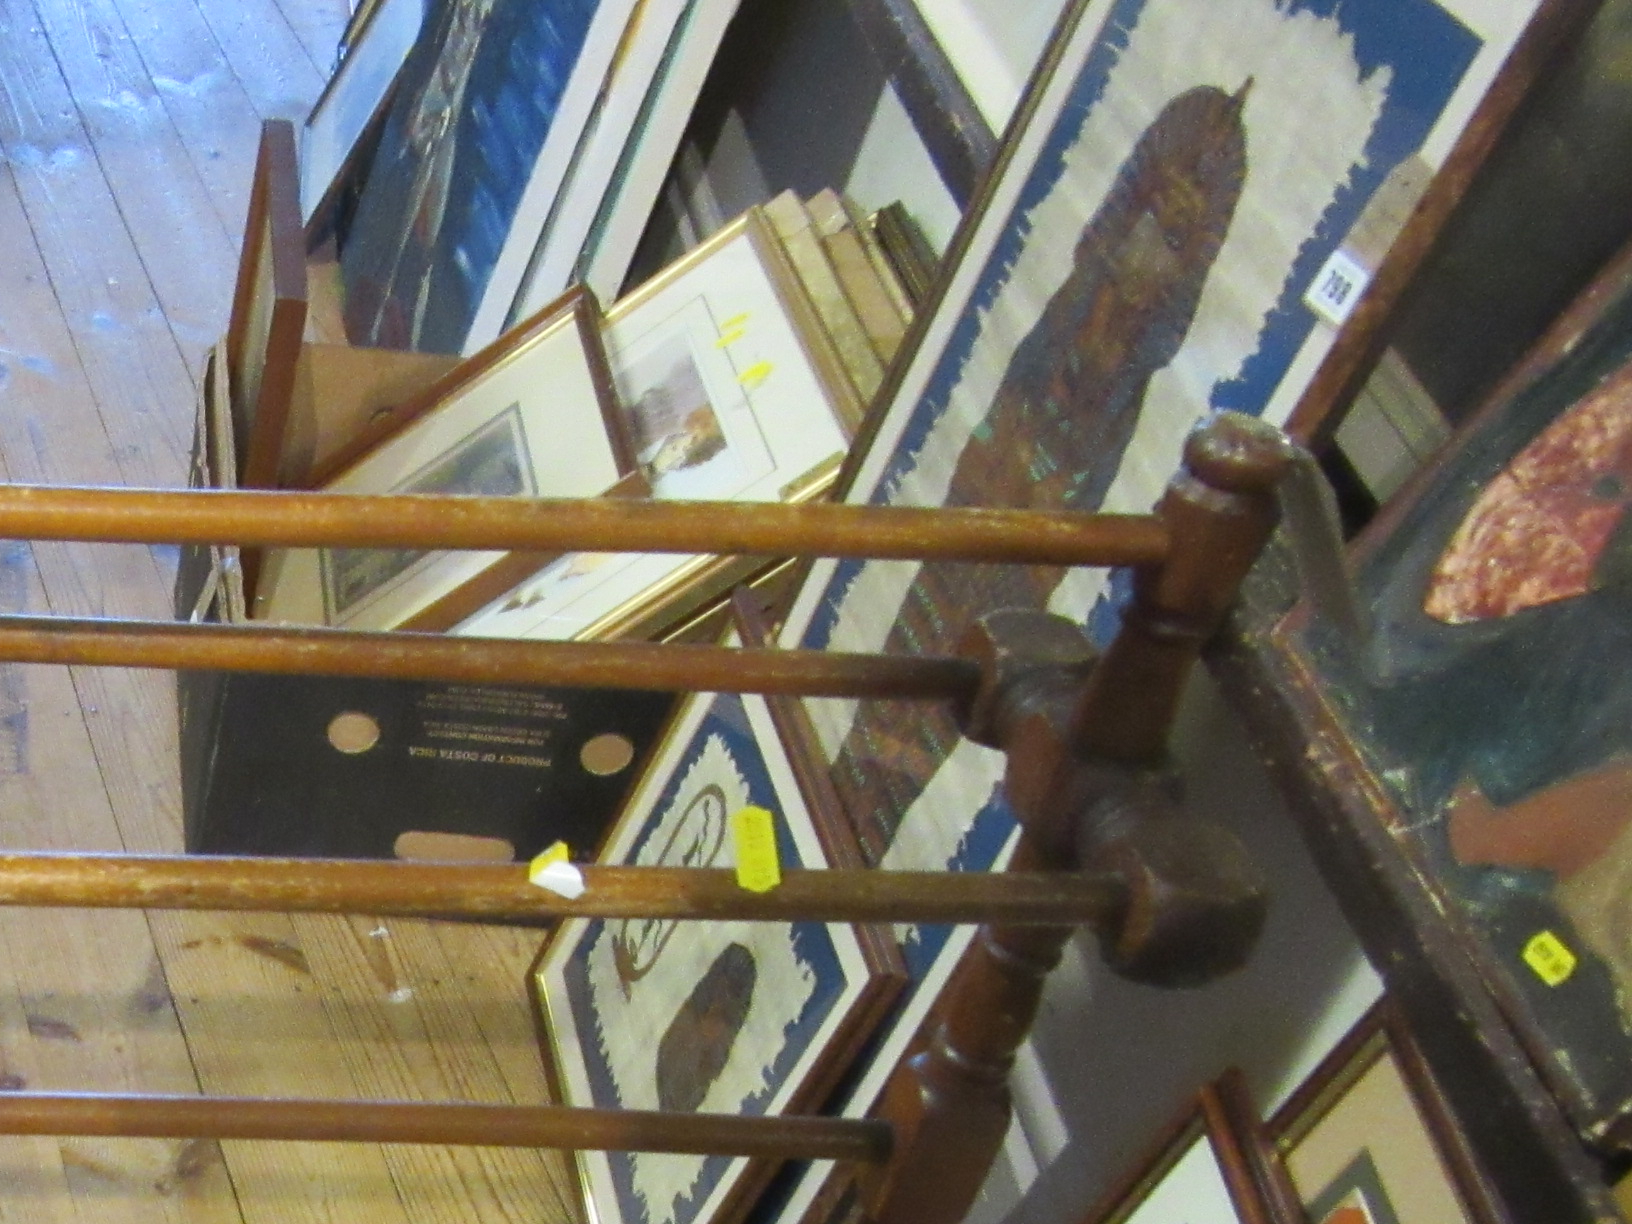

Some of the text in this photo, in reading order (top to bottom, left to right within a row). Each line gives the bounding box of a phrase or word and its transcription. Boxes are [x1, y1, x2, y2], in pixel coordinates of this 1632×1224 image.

[409, 745, 552, 768] PRODUCT OF COSTA RICA
